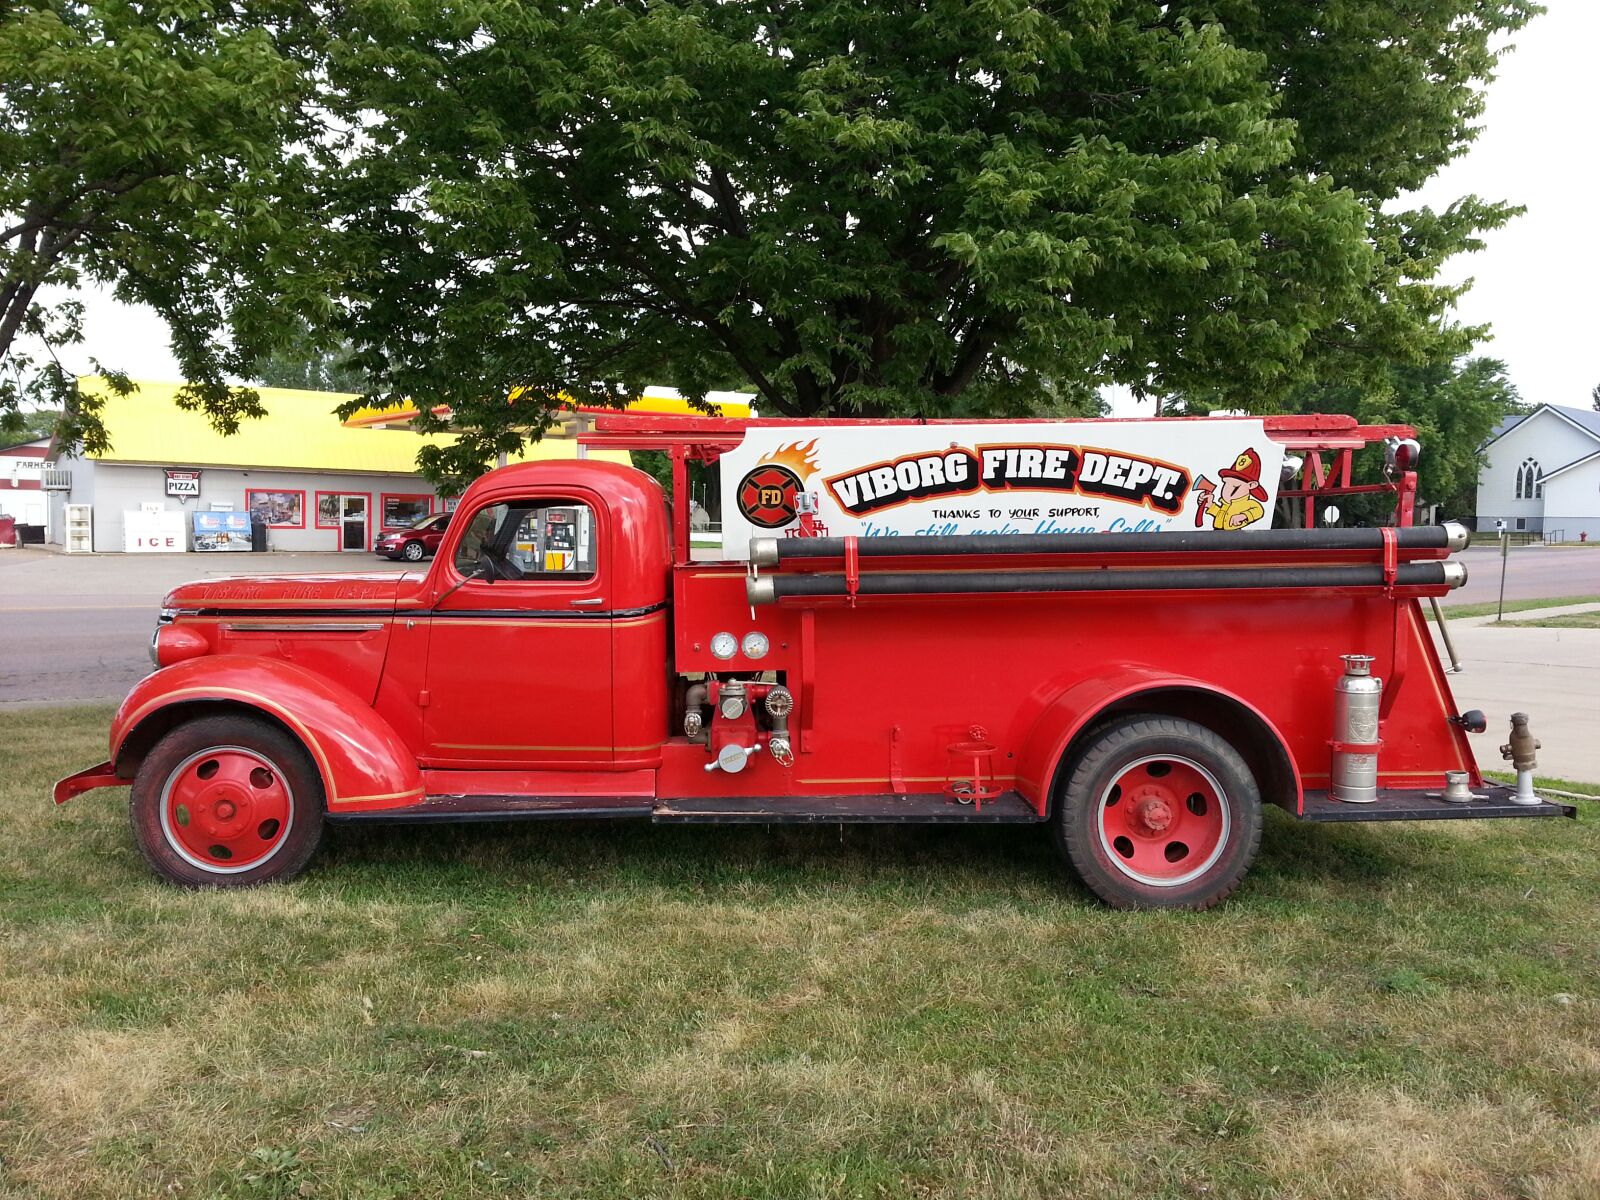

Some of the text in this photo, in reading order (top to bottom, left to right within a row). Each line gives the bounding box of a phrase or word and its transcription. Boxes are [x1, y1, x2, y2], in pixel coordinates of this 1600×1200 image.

[830, 447, 1183, 509] VIBORG FIRE DEPT.
[168, 482, 197, 491] PIZZA
[761, 489, 782, 505] FD
[931, 506, 1101, 520] THANKS TO YOUR SUPPORT,
[137, 537, 175, 547] ICE
